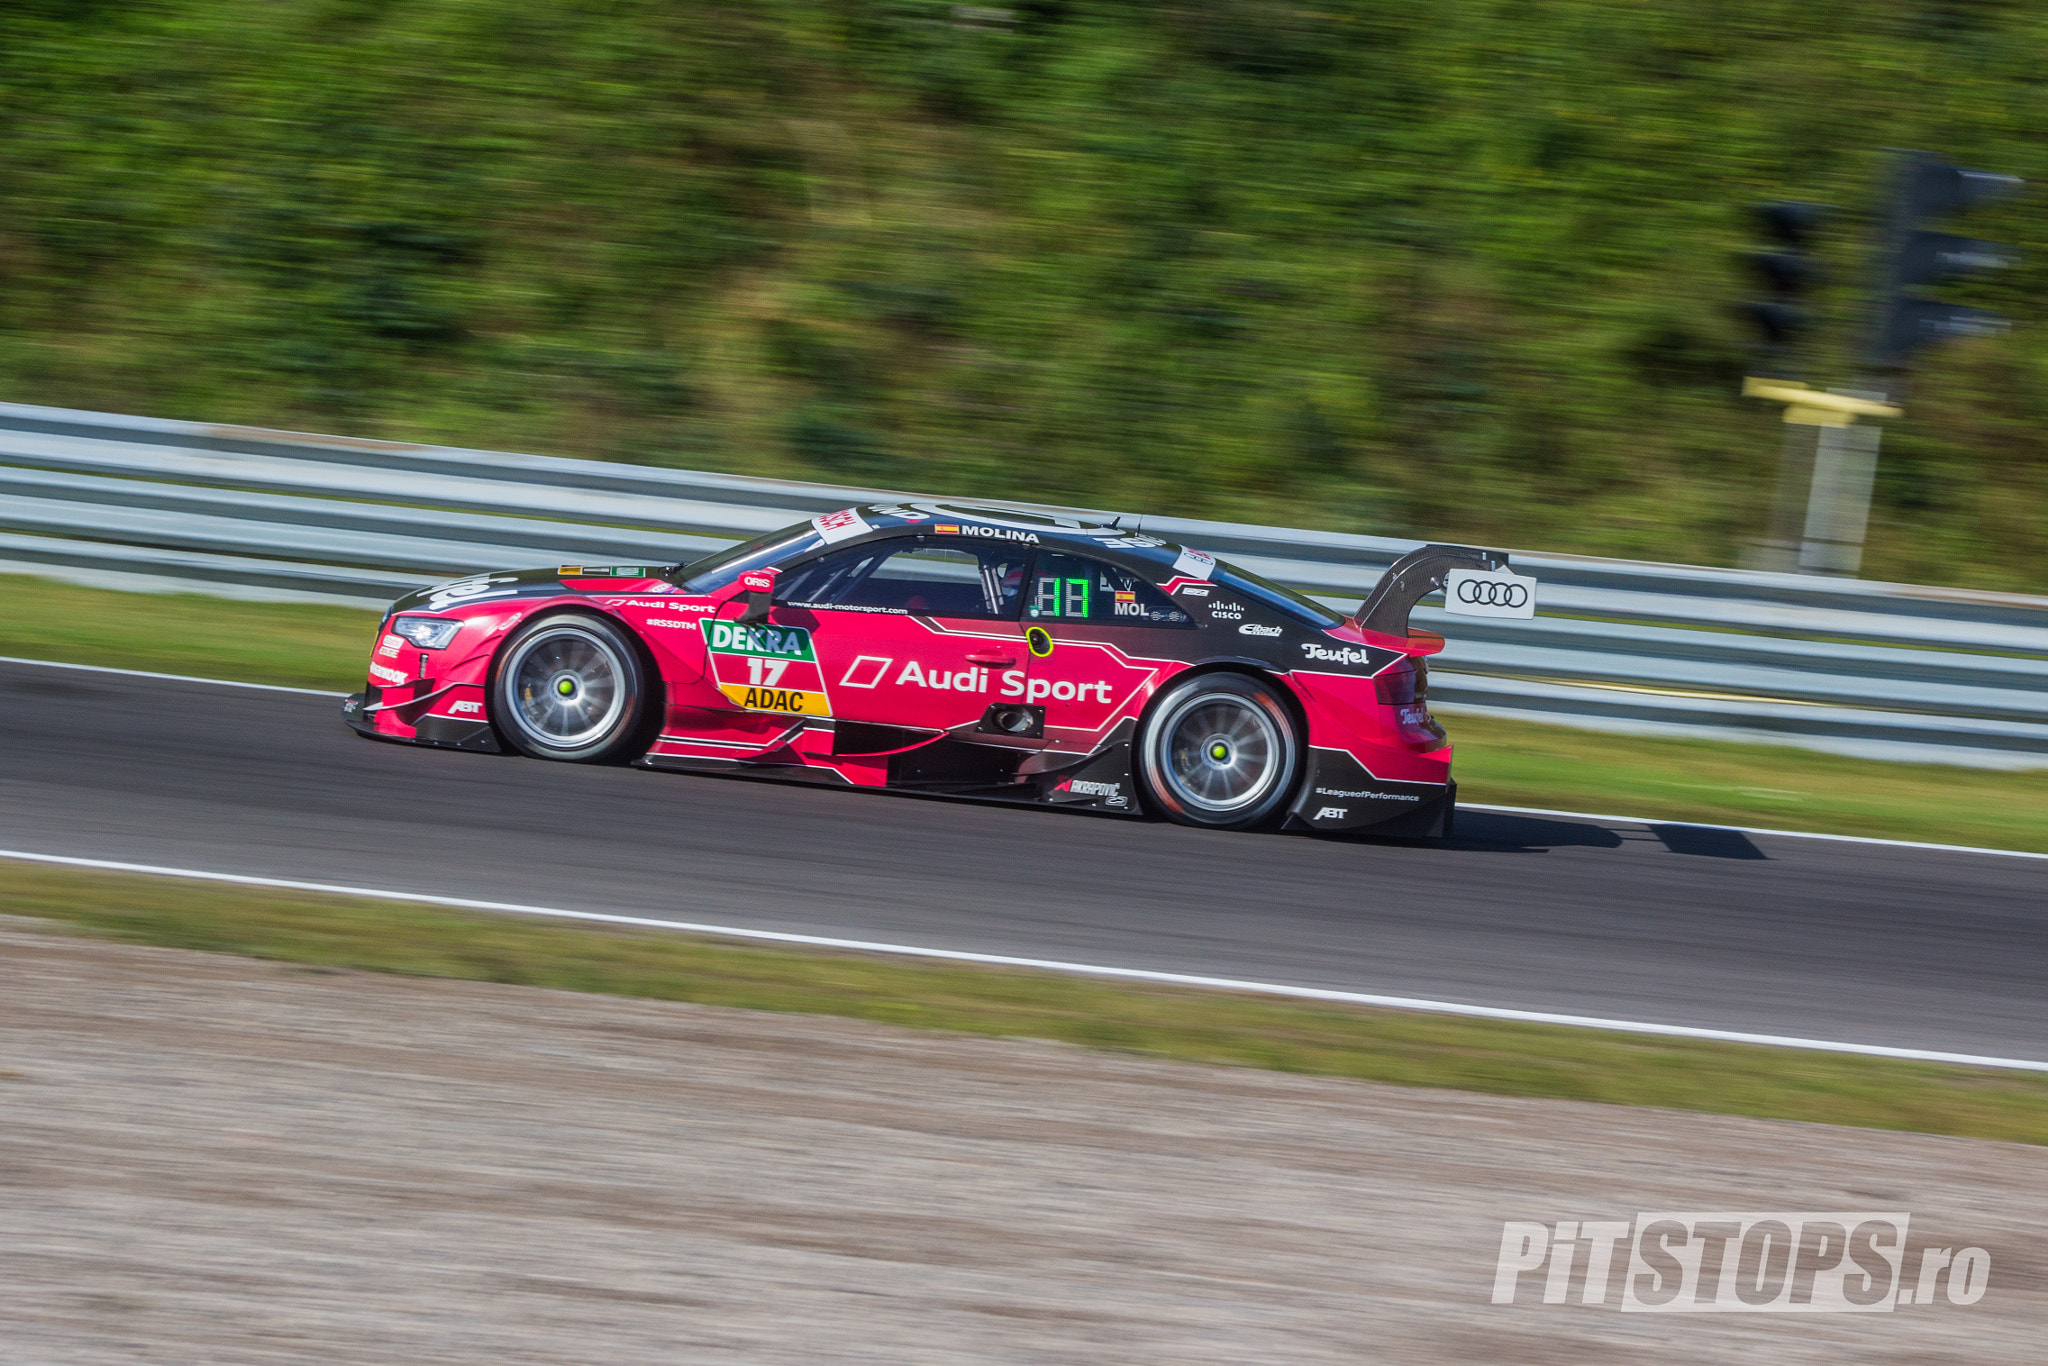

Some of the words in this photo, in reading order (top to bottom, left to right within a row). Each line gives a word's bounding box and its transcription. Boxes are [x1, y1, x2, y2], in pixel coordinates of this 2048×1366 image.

[961, 525, 1040, 544] MOLINA
[743, 576, 770, 588] ORIS
[626, 600, 665, 608] Audi
[668, 602, 716, 613] Sport
[787, 601, 908, 615] www.audi-motorsport.com
[1114, 602, 1149, 617] MOL
[646, 619, 697, 630] #RSSDTM
[712, 624, 802, 656] DEKRA
[1301, 643, 1370, 665] Teufel
[747, 657, 790, 687] 17
[895, 660, 988, 693] Audi
[1000, 670, 1113, 704] Sport
[447, 700, 483, 714] ABT
[744, 688, 804, 712] ADAC
[1315, 787, 1420, 802] #LeagueofPerformance
[1313, 807, 1348, 820] ABT
